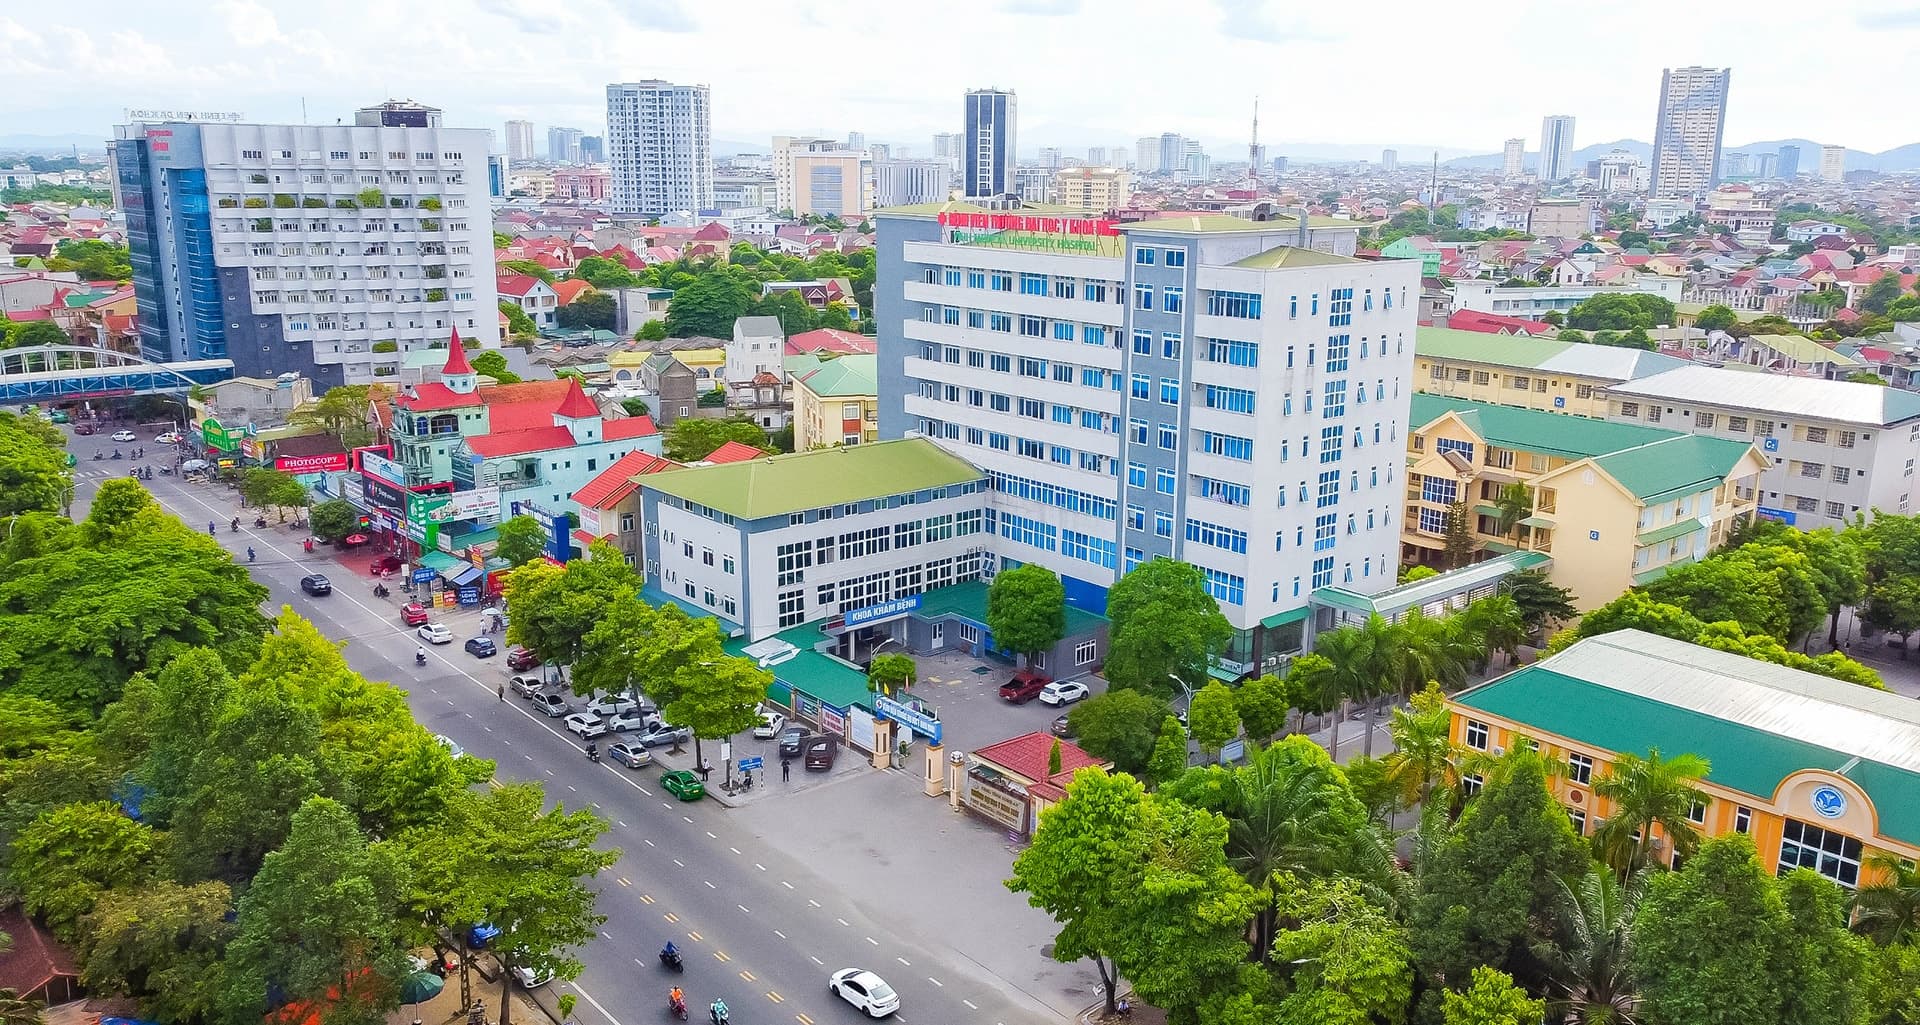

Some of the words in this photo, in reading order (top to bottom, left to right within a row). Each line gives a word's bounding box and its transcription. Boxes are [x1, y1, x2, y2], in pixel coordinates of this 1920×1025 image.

[284, 456, 338, 468] PHOTOCOPY
[852, 611, 873, 622] KHOA
[873, 604, 896, 617] KHÁM
[896, 598, 917, 611] BỆNH
